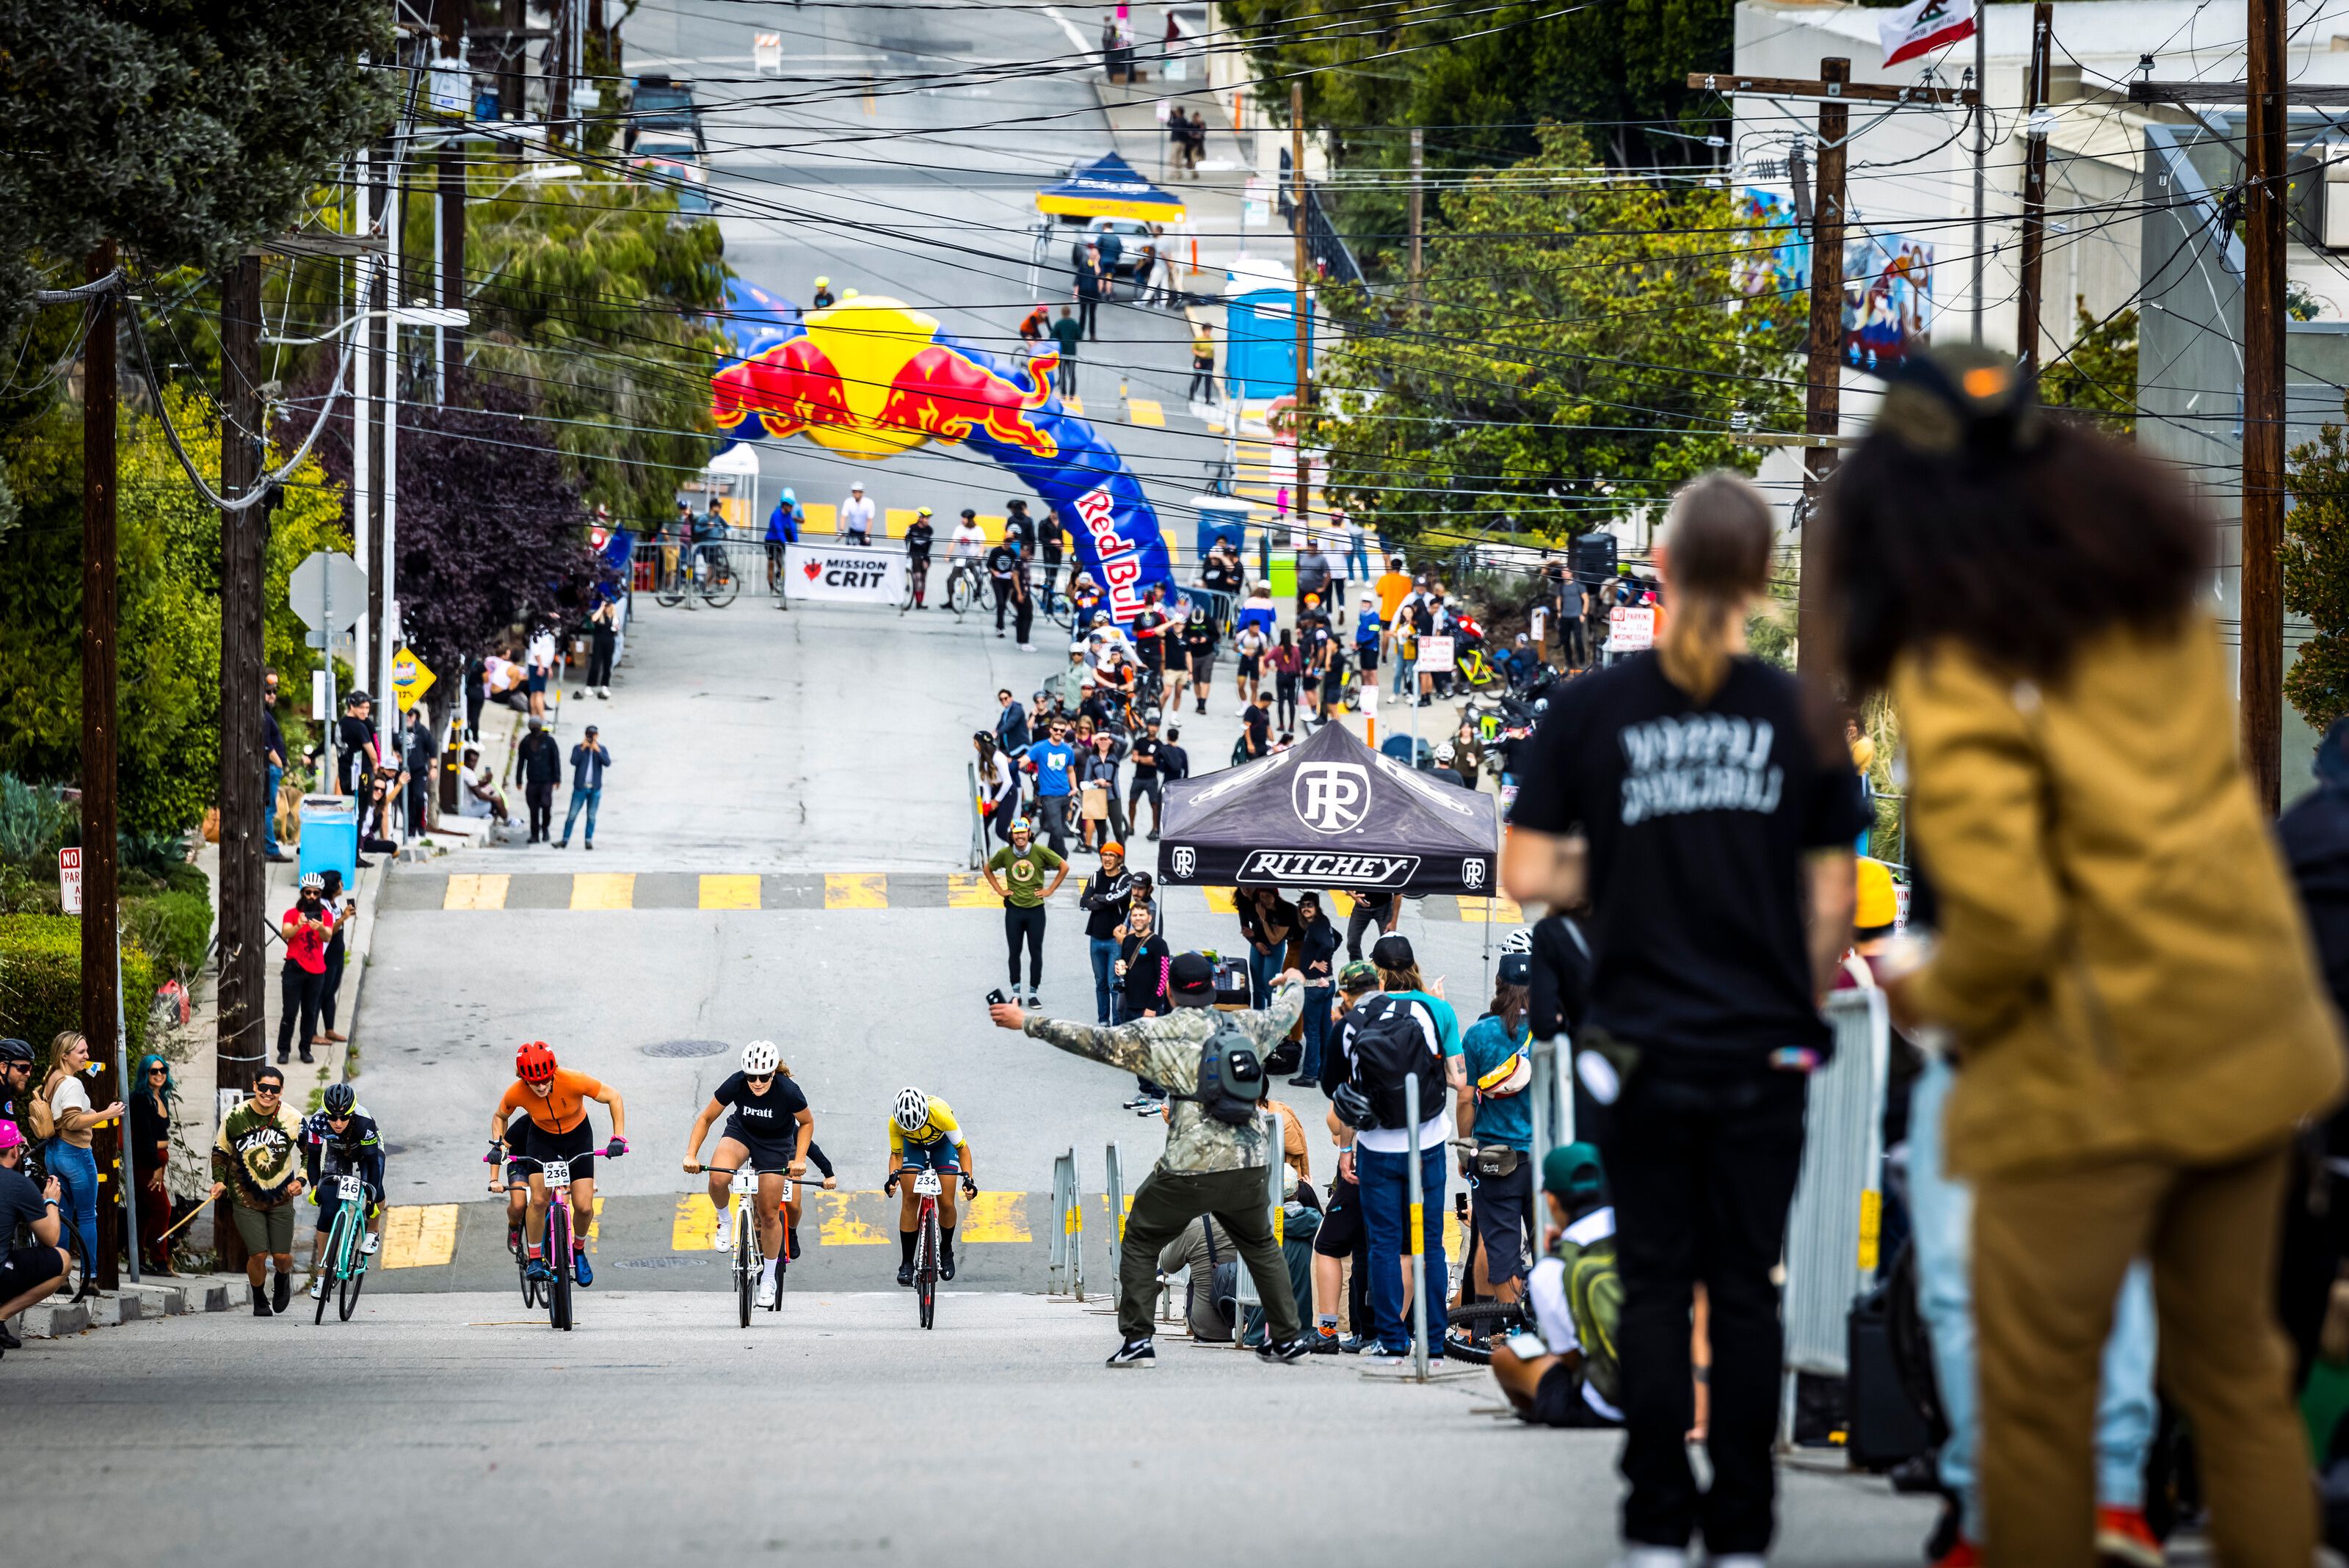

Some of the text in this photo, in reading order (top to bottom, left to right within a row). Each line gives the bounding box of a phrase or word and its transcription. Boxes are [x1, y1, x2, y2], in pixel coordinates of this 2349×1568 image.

[1078, 490, 1132, 556] Red
[826, 559, 887, 570] MISSION
[826, 570, 885, 588] CRIT
[62, 852, 78, 866] NO
[1250, 852, 1407, 882] RITCHEY
[743, 1106, 774, 1118] pratt
[546, 1169, 567, 1180] 236
[743, 1176, 748, 1187] 1
[917, 1177, 937, 1186] 234
[341, 1183, 358, 1194] 46
